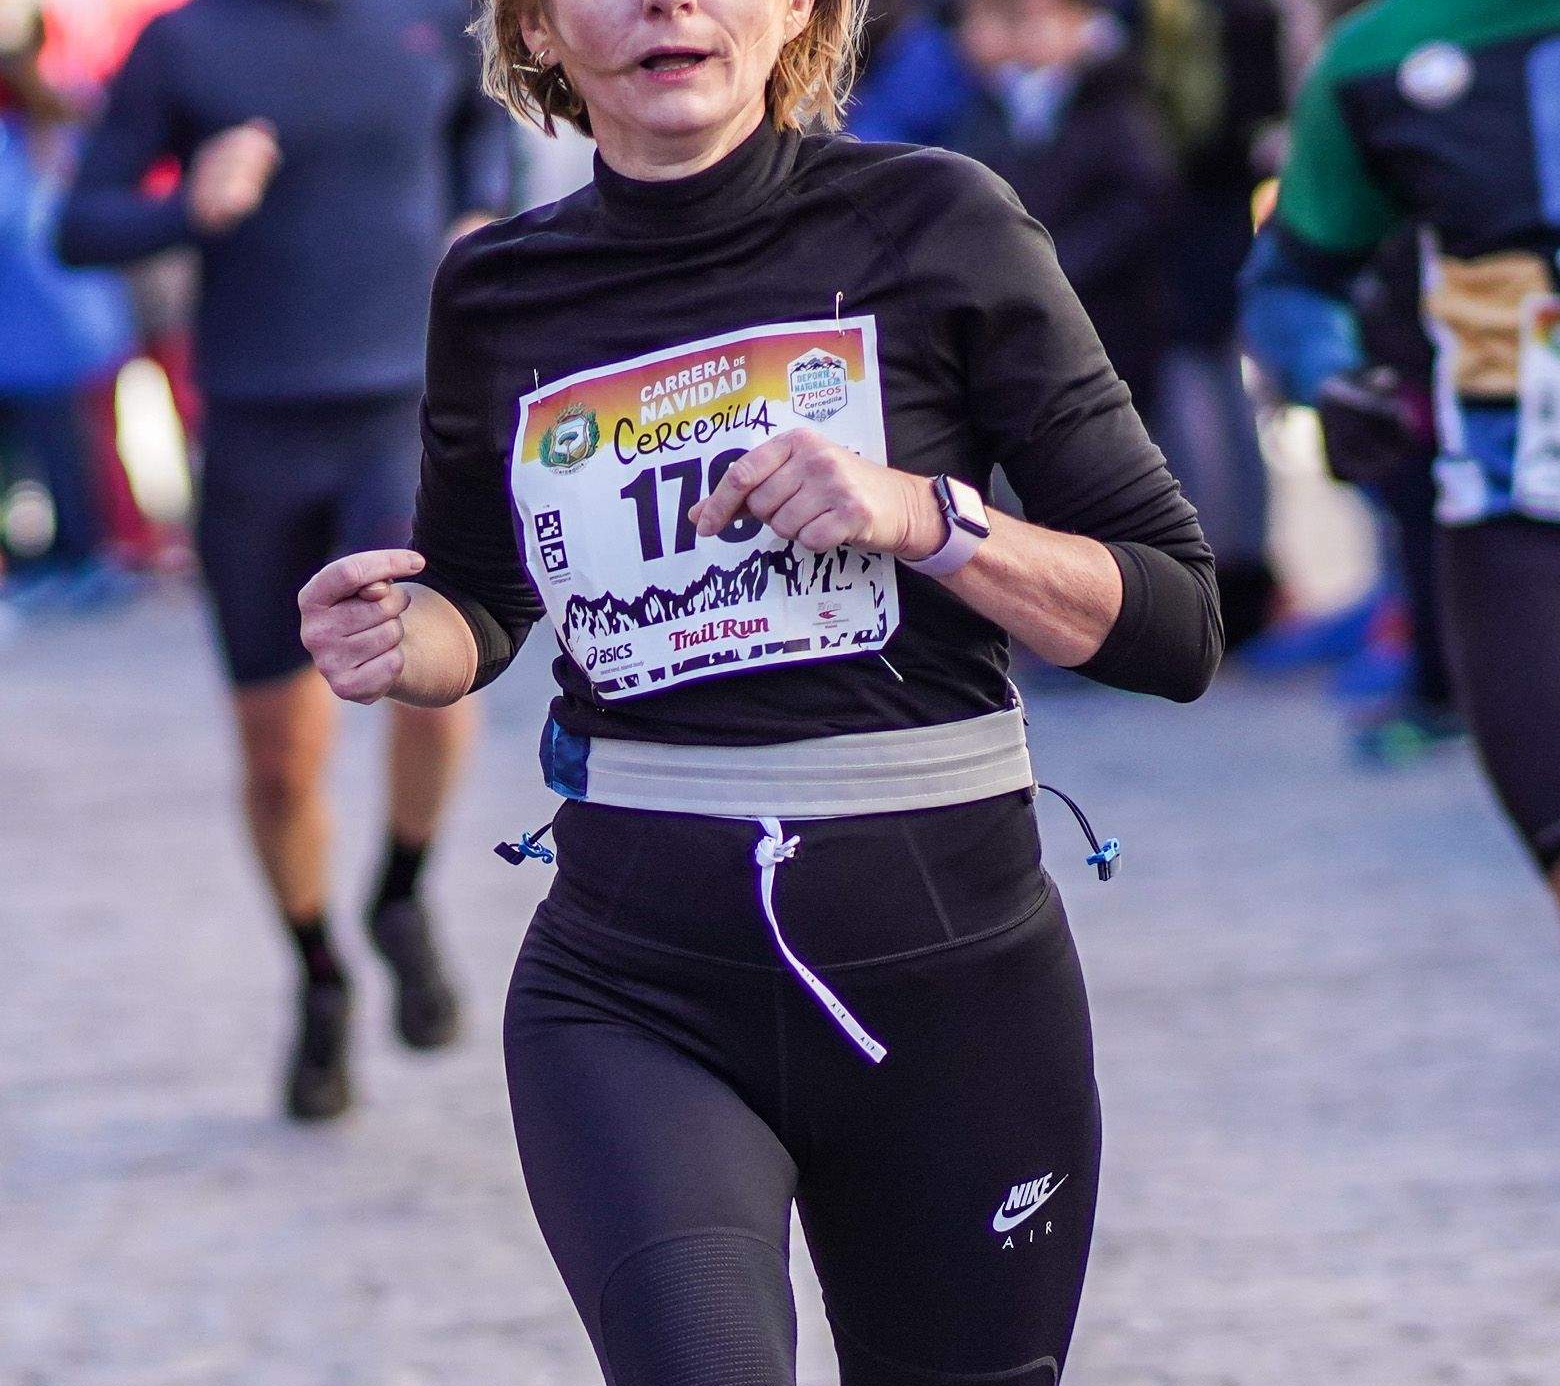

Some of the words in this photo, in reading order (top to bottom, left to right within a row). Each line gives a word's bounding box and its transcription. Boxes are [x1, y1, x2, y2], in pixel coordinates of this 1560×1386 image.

[639, 355, 730, 403] CARRERA
[733, 355, 747, 368] DE
[796, 369, 830, 383] DEPORTE
[640, 368, 747, 425] NAVIDAD
[796, 393, 806, 407] 7
[808, 386, 842, 400] PICOS
[804, 396, 842, 409] Cercedilla
[669, 622, 718, 651] Trail
[717, 617, 769, 639] Run
[1005, 1172, 1053, 1211] NIKE
[1002, 1221, 1052, 1250] AIR
